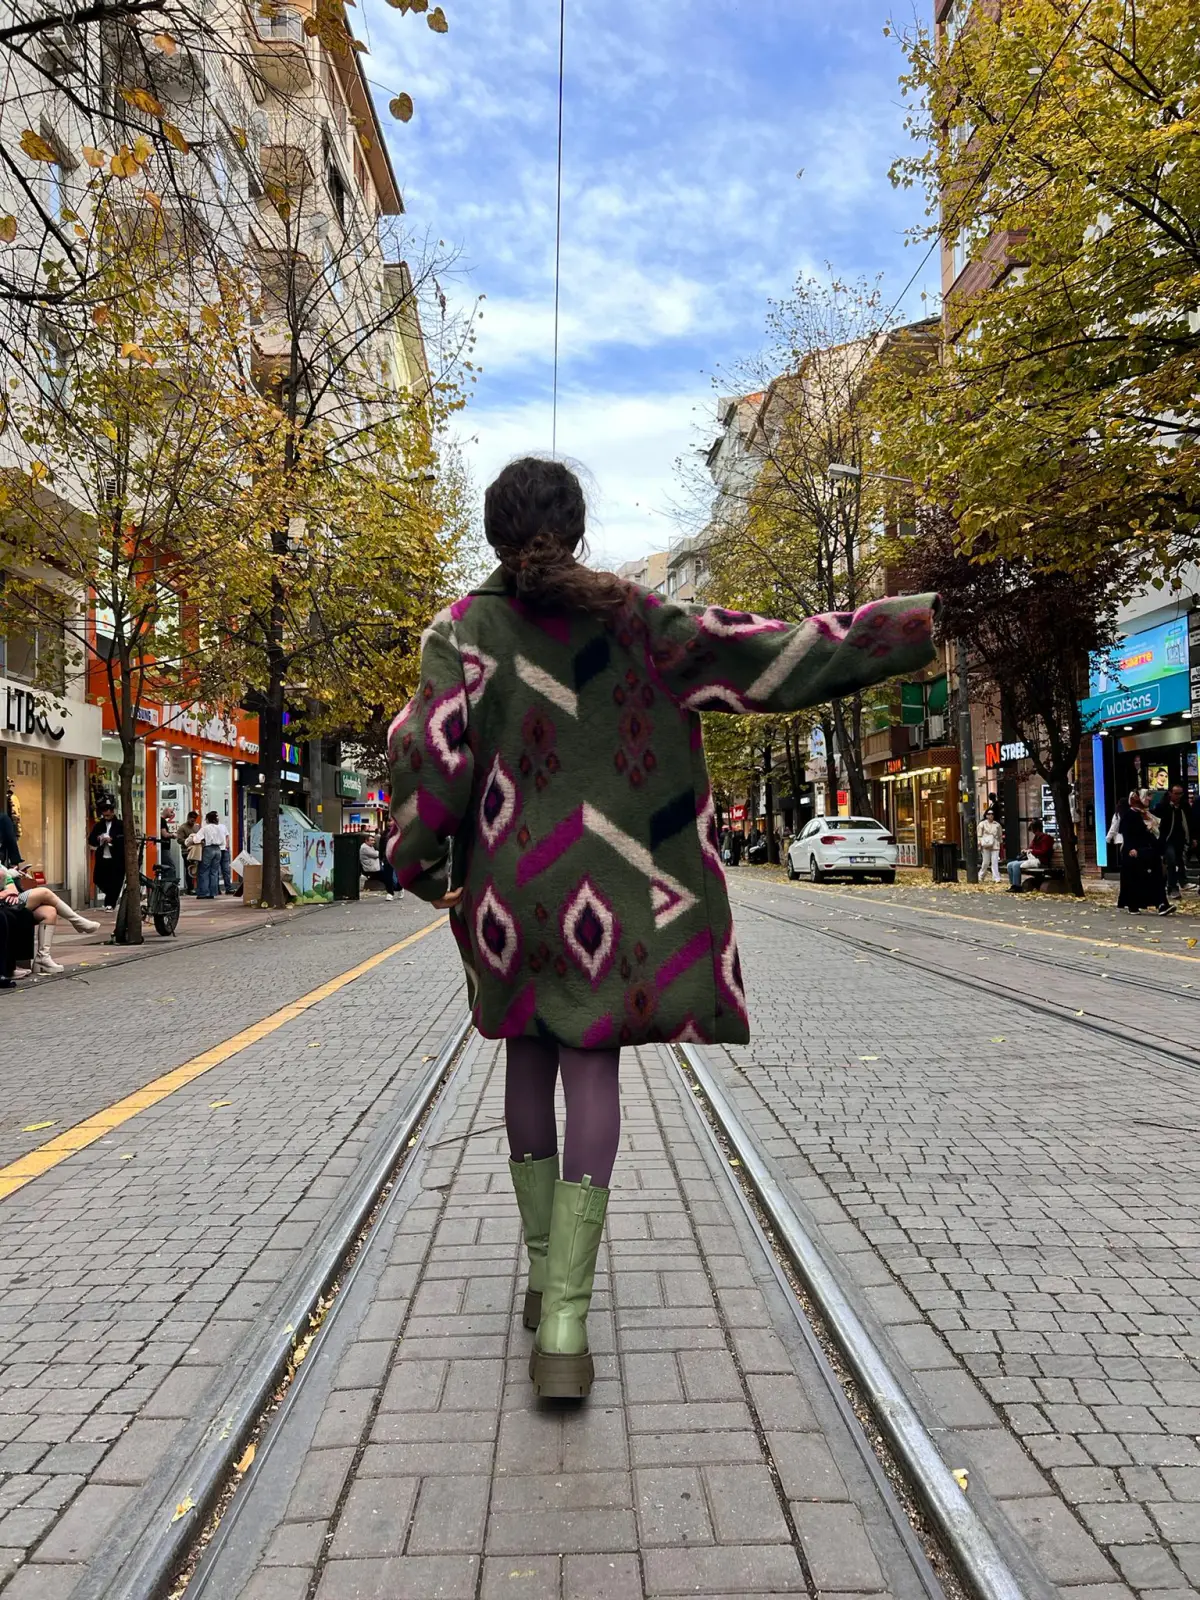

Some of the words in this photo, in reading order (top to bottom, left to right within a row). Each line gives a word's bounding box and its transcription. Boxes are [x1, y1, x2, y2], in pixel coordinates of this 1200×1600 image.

[1106, 693, 1152, 716] watsons
[985, 741, 1000, 768] IN
[16, 758, 39, 777] LTB
